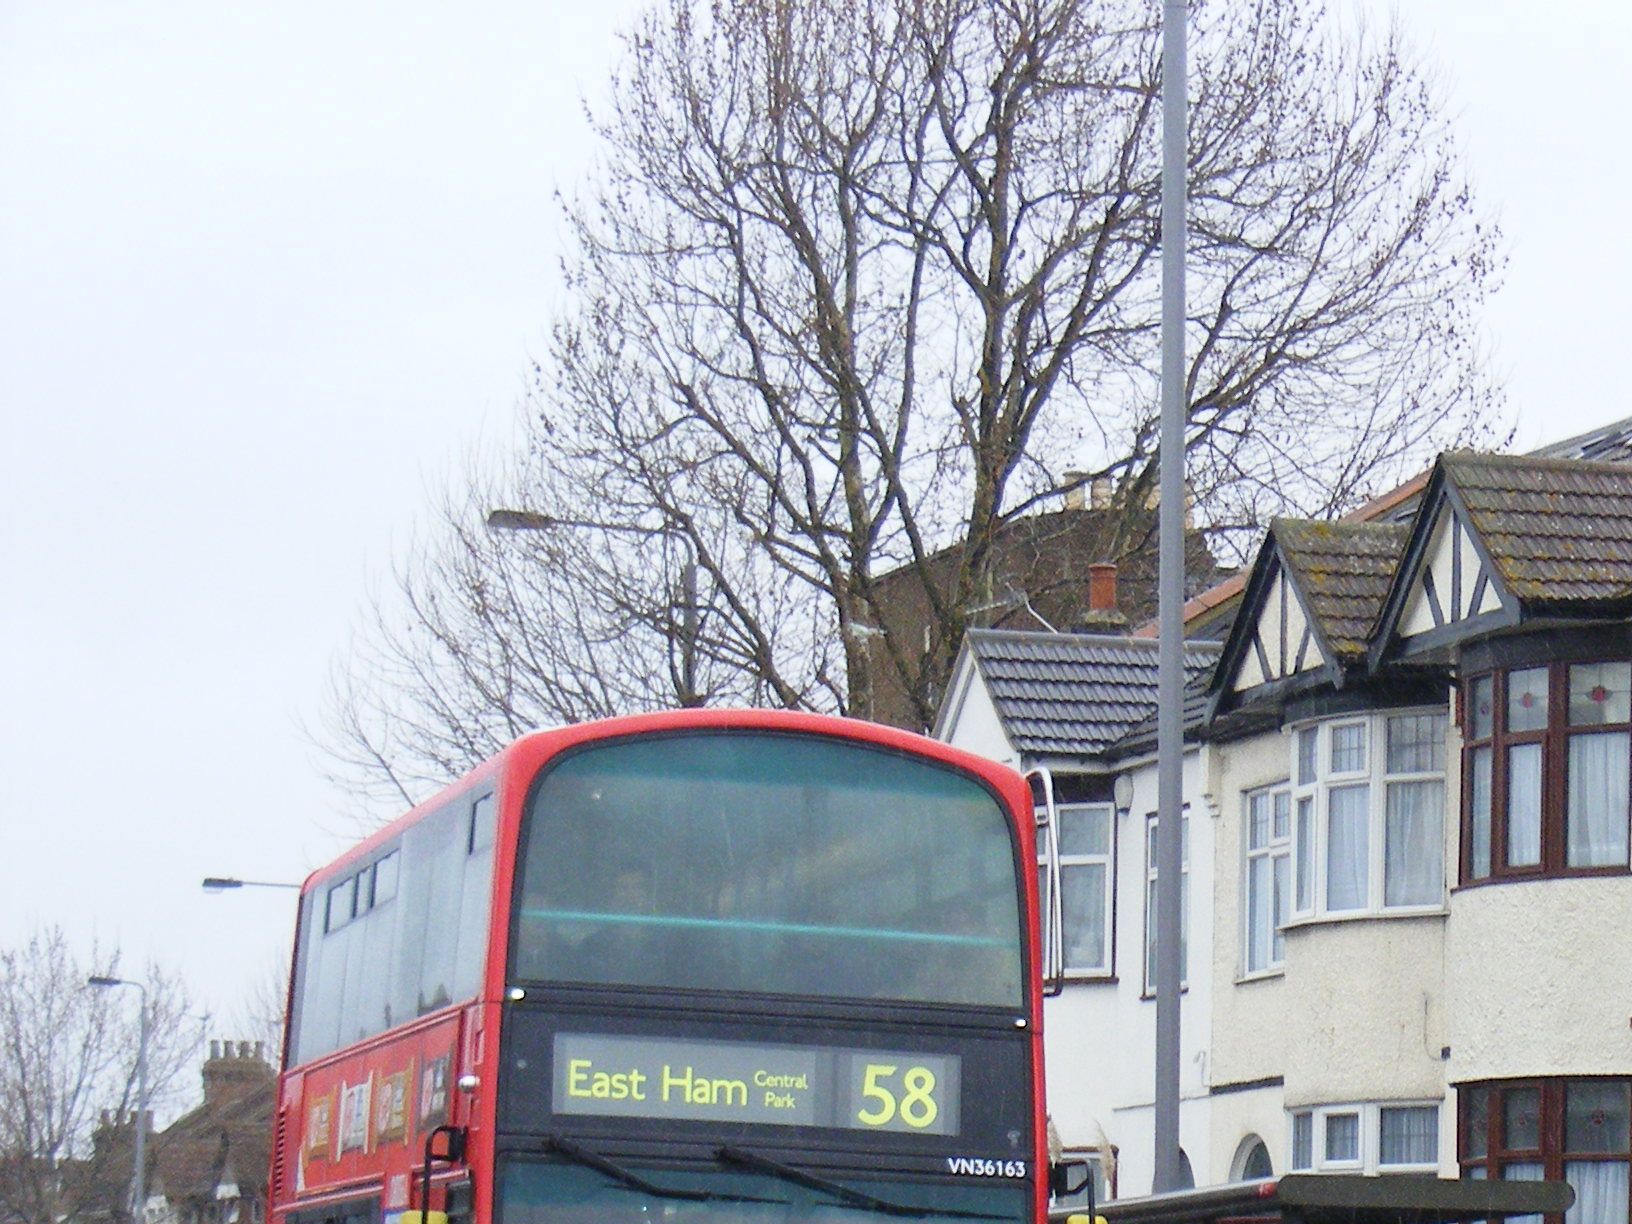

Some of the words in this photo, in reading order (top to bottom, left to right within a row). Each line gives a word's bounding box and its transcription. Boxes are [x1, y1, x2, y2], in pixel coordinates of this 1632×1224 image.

[568, 1059, 646, 1100] East
[661, 1065, 748, 1106] Ham
[754, 1069, 808, 1092] Central
[764, 1091, 796, 1110] Park
[858, 1063, 938, 1128] 58
[948, 1156, 1026, 1178] VN36163
